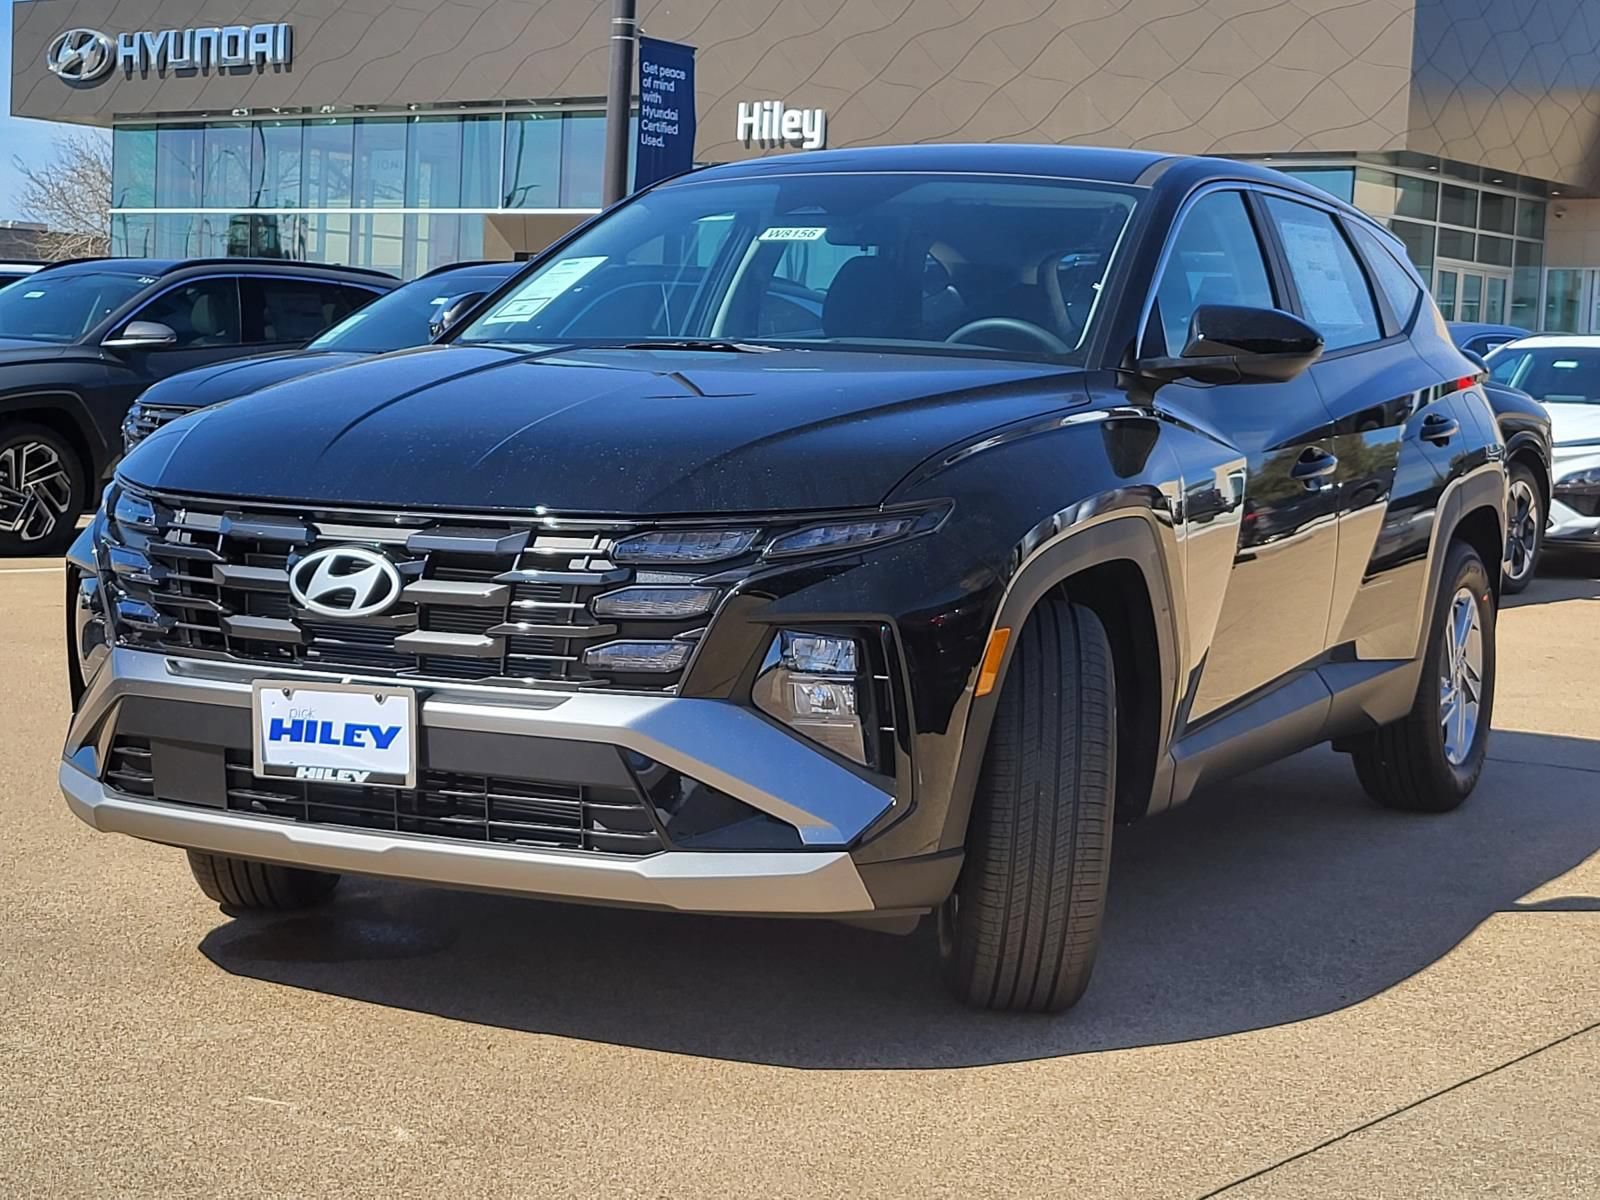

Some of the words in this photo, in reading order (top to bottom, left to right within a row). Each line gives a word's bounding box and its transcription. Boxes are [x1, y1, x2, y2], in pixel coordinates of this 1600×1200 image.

[117, 22, 290, 71] HYUNDAI
[642, 61, 659, 76] Get
[659, 66, 686, 80] peace
[642, 76, 652, 88] of
[653, 78, 675, 92] mind
[642, 90, 662, 105] with
[642, 104, 679, 121] Hyundai
[641, 119, 679, 135] Certified
[736, 100, 825, 150] Hiley
[640, 133, 665, 148] Used.
[767, 228, 819, 239] W8156
[268, 717, 403, 751] HILEY
[295, 765, 372, 784] HILEY
